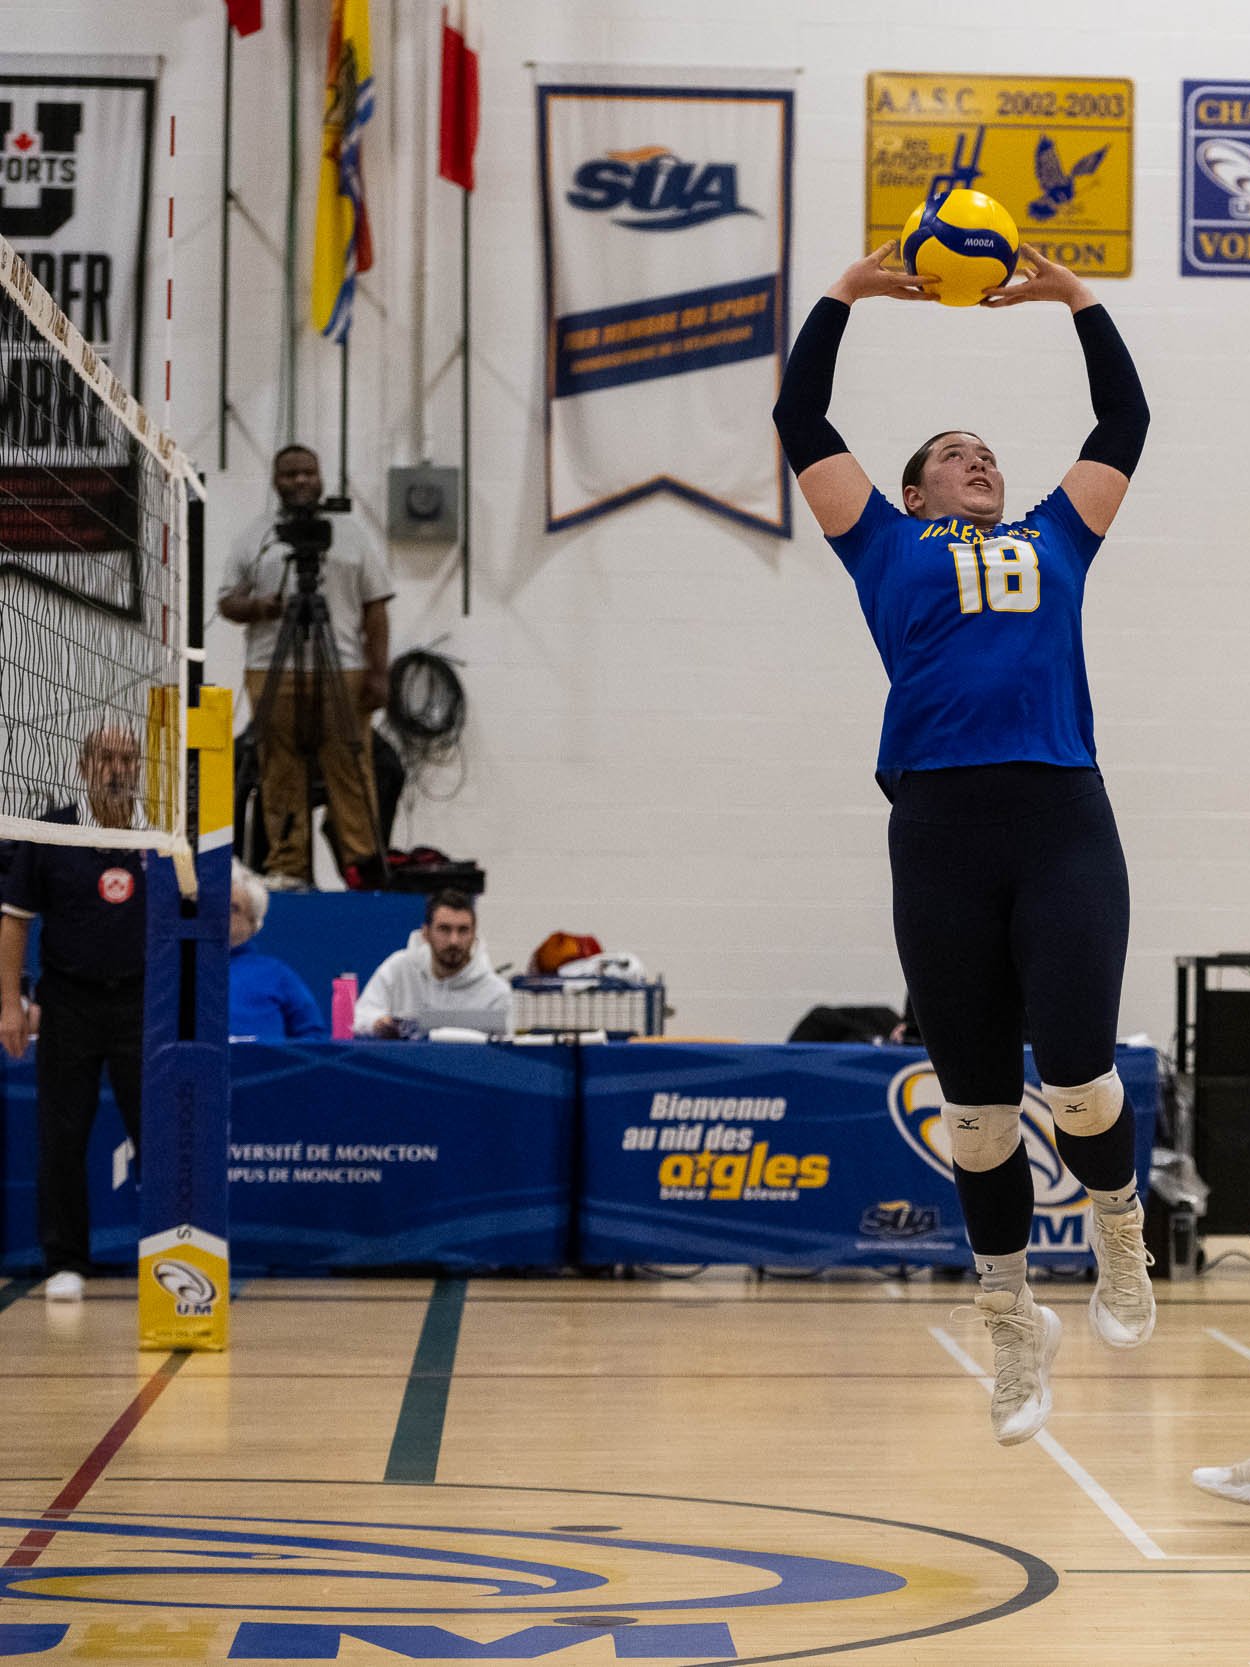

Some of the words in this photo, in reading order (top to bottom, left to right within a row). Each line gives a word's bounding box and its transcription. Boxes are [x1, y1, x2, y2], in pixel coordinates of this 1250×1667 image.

[998, 91, 1125, 118] 2002-2003
[964, 238, 994, 248] V200W
[948, 536, 1041, 614] 18
[649, 1092, 787, 1121] Bienvenue
[621, 1126, 657, 1151] au
[657, 1122, 704, 1151] nid
[704, 1123, 754, 1151] des
[306, 1144, 330, 1162] DE
[334, 1144, 438, 1163] MONCTON
[268, 1167, 289, 1183] DE
[292, 1167, 382, 1183] MONCTON
[657, 1140, 830, 1200] aigles
